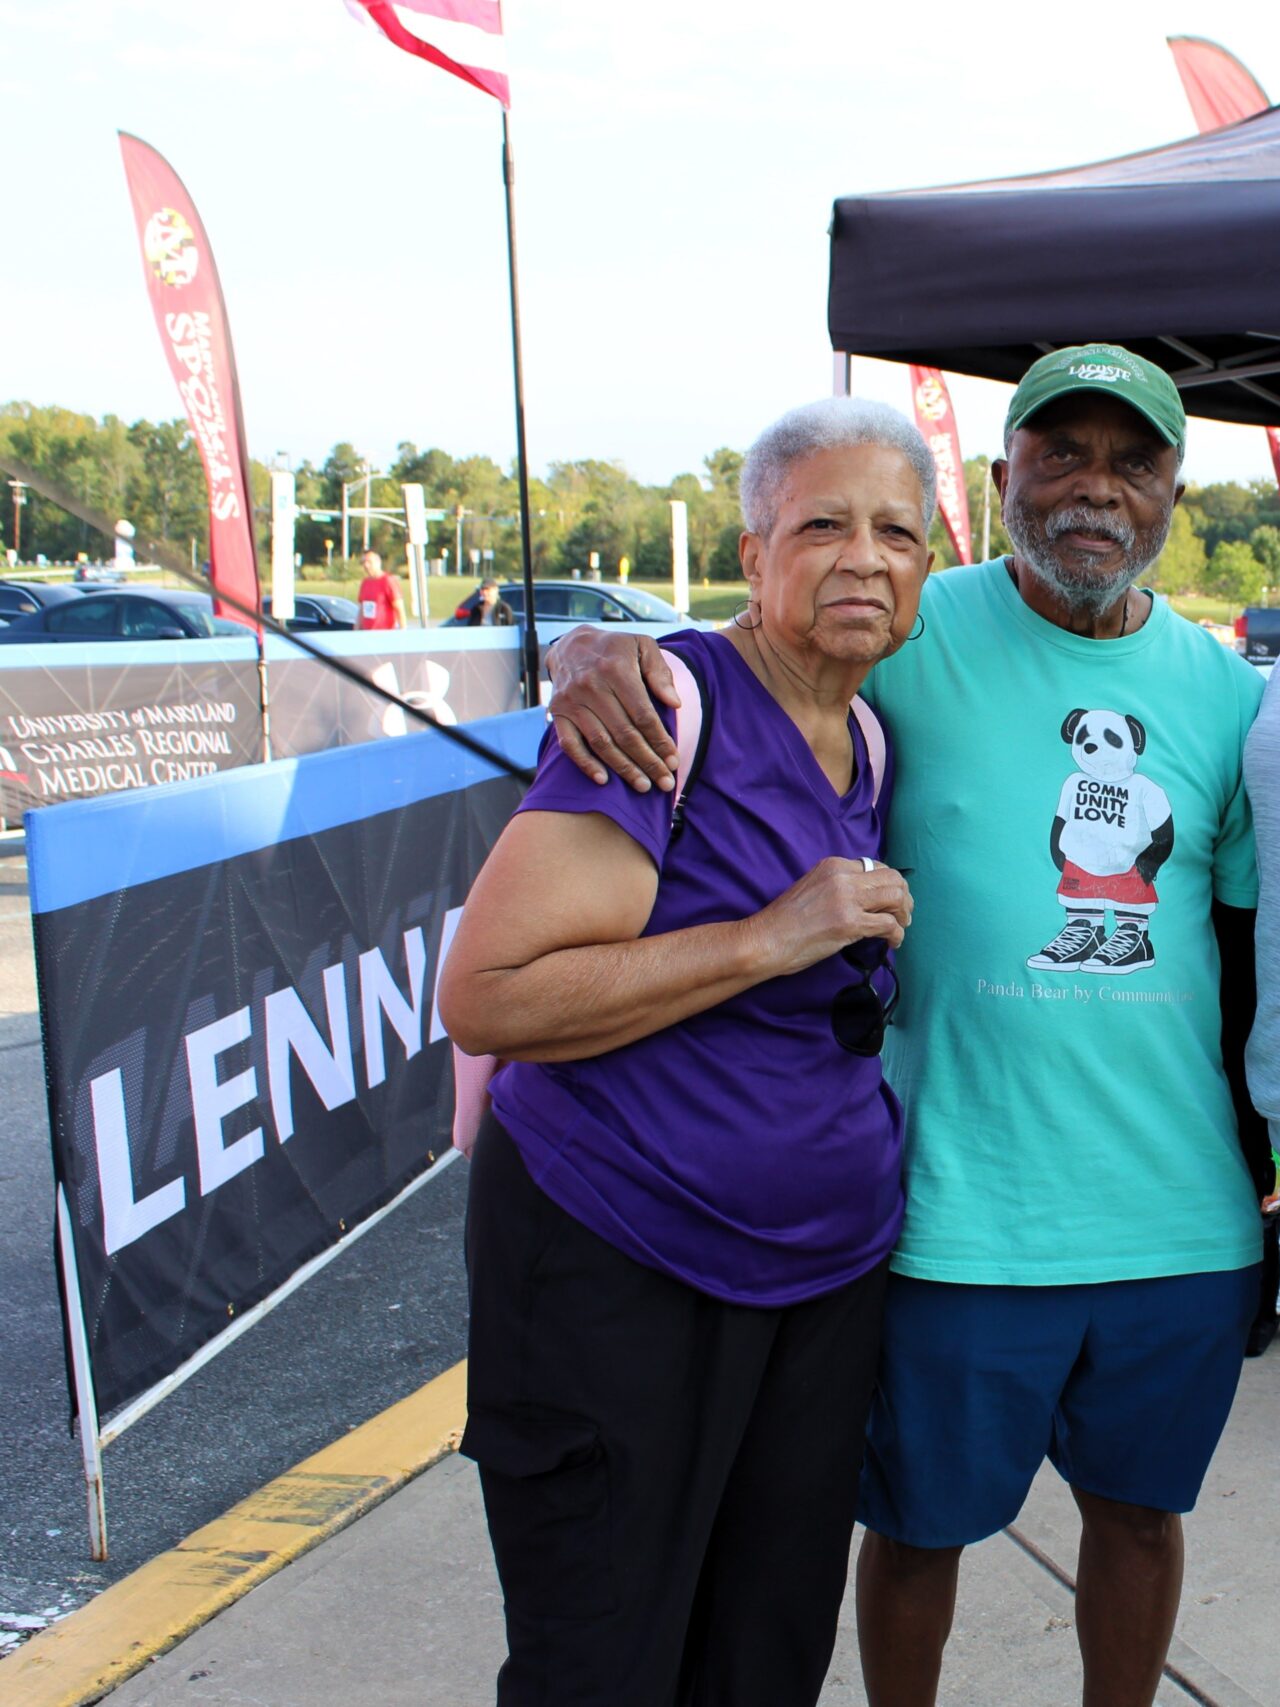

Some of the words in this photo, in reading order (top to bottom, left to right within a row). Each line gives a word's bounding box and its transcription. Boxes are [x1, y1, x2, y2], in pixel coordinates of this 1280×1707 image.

[1068, 363, 1131, 382] LACOSTE
[8, 710, 130, 739] UNIVERSITY
[131, 709, 144, 727] of
[143, 702, 236, 726] MARYLAND
[20, 732, 136, 764] CHARLES
[138, 729, 232, 756] REGIONAL
[37, 762, 148, 796] MEDICAL
[150, 758, 218, 786] CENTER
[1077, 780, 1129, 801] COMM
[1076, 792, 1128, 814] UNITY
[1074, 807, 1126, 829] LOVE
[978, 978, 1025, 998] Panda
[1031, 982, 1069, 1000] Bear
[1074, 984, 1094, 1004] by
